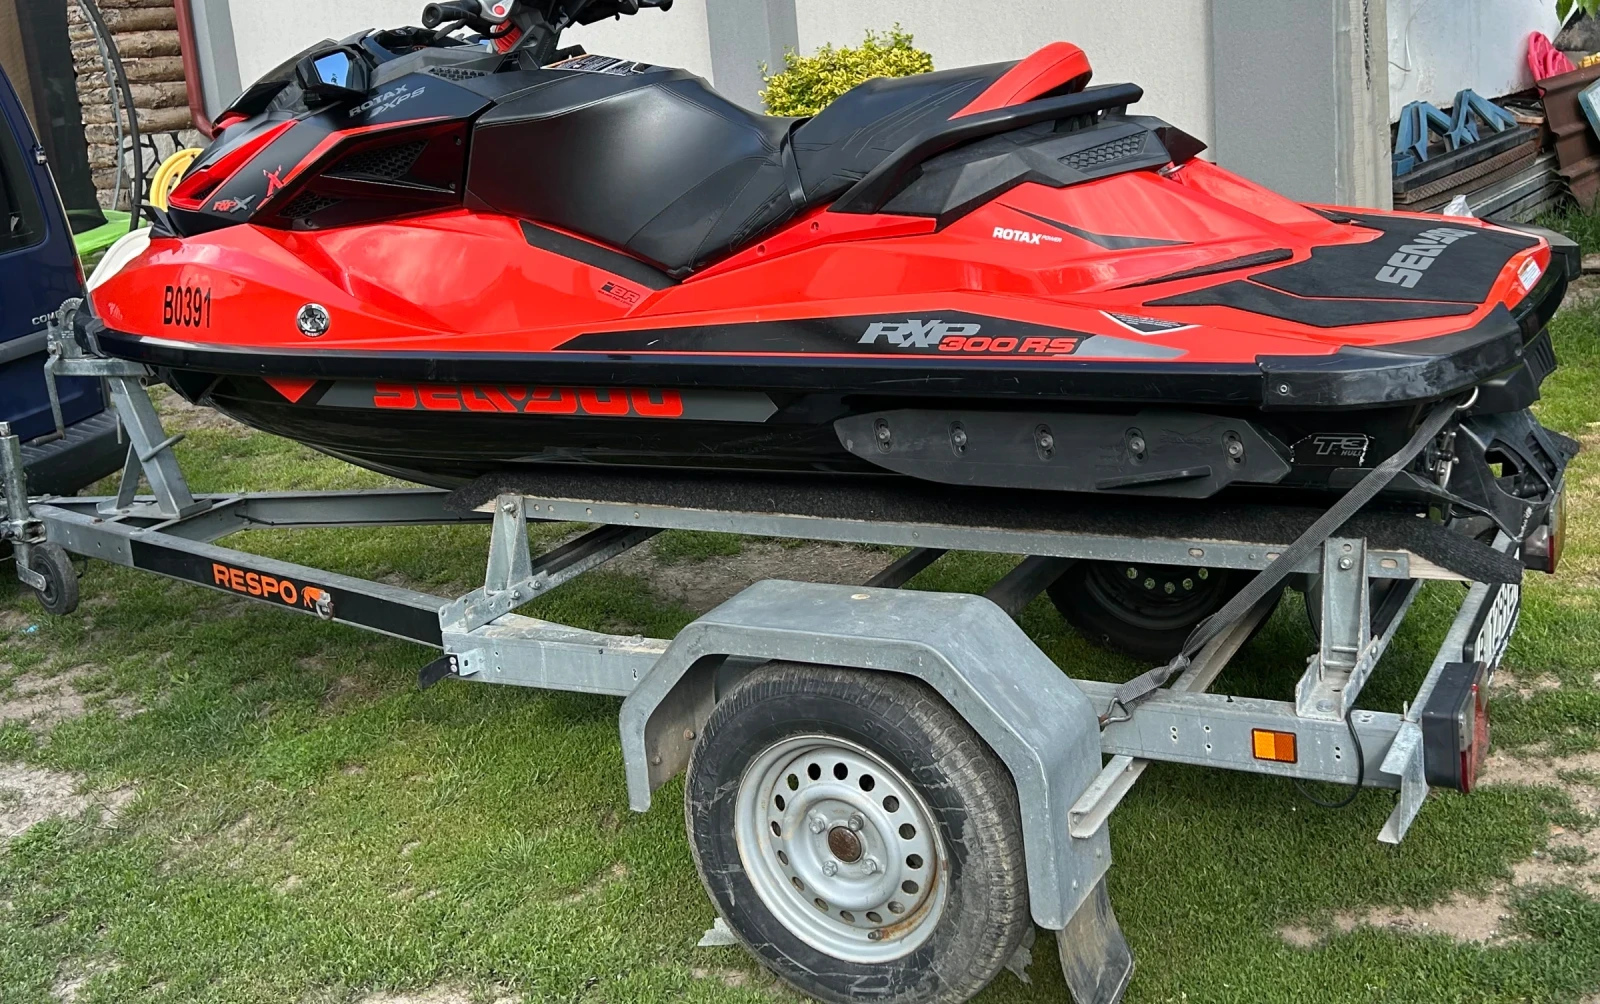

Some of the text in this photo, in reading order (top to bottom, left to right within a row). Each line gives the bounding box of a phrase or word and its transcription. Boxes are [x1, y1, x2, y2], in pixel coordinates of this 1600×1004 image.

[349, 84, 408, 117] ROTAX
[992, 226, 1063, 245] ROTAX POWER
[163, 285, 212, 329] B0391
[857, 319, 981, 348] RXP
[938, 336, 1078, 353] 300 RS
[1313, 436, 1368, 455] T3
[212, 563, 298, 605] RESPO
